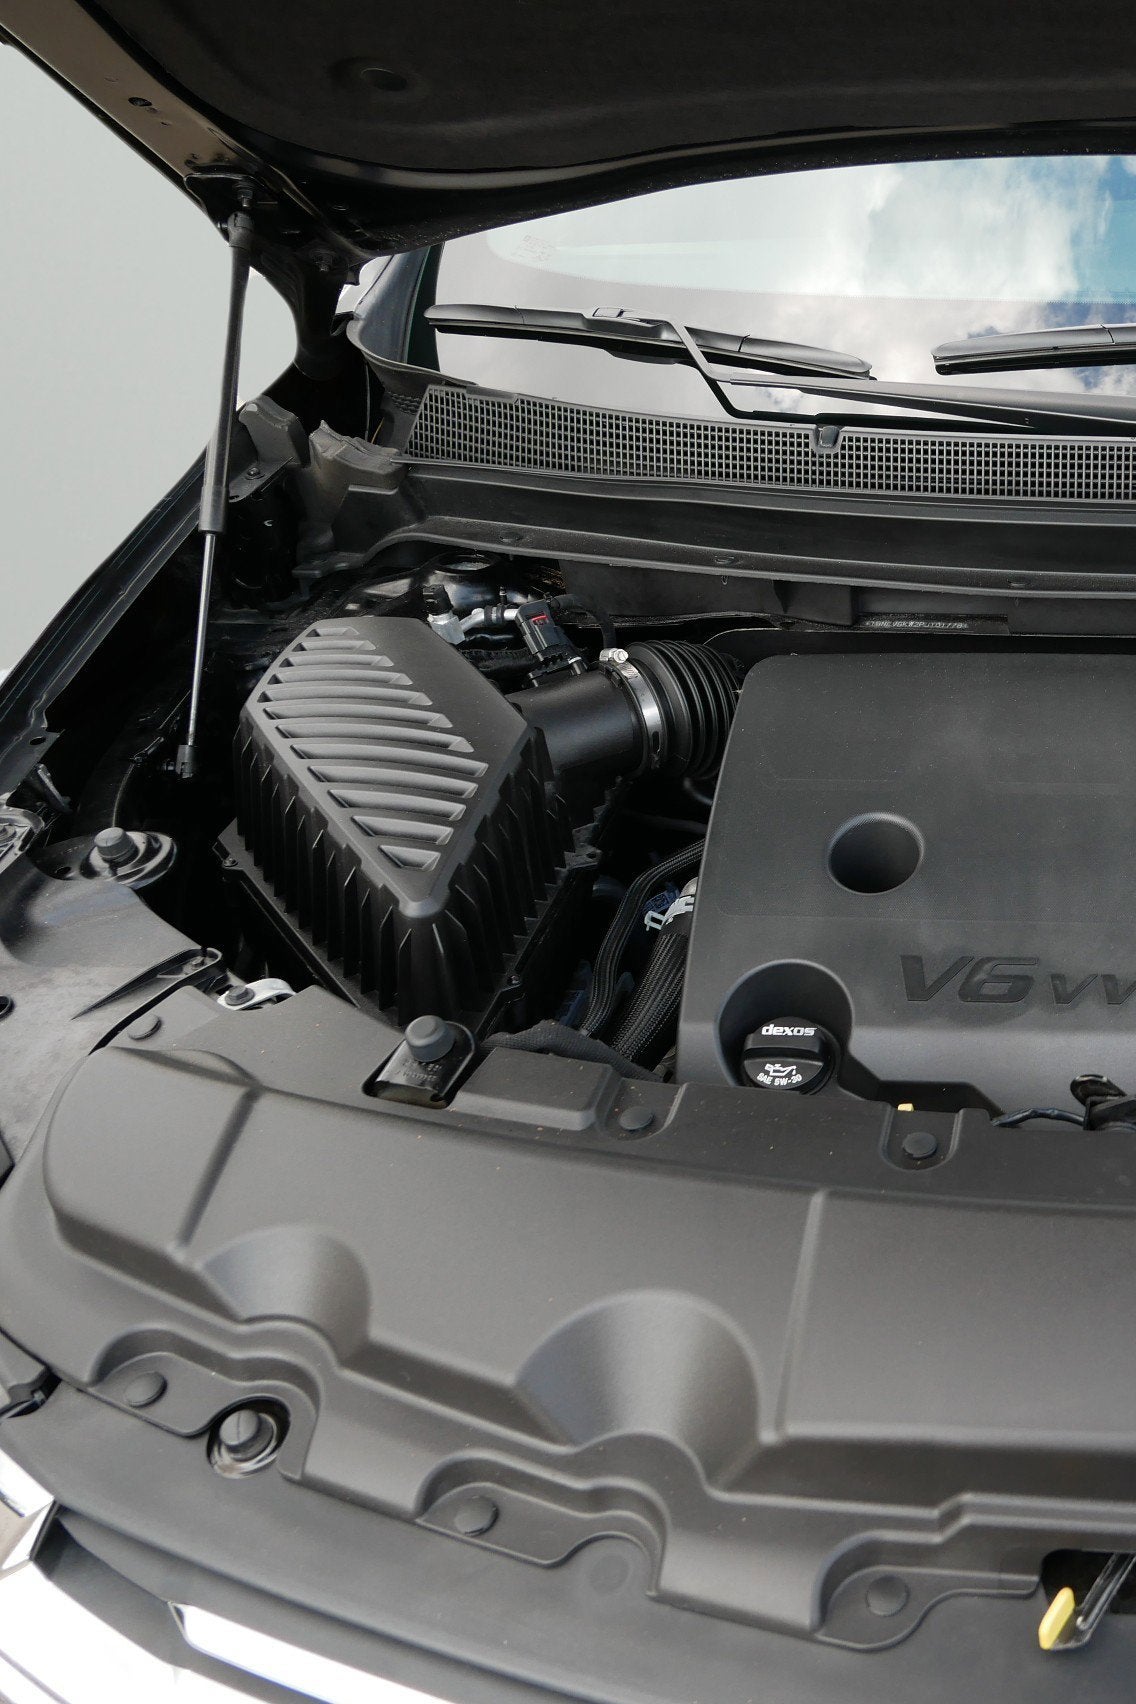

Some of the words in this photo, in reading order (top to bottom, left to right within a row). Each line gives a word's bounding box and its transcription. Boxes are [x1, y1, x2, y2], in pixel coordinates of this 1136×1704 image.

[900, 955, 1039, 1004] V6
[761, 1024, 817, 1036] dexos
[757, 1073, 773, 1085] SAE
[774, 1073, 802, 1086] 5W-30
